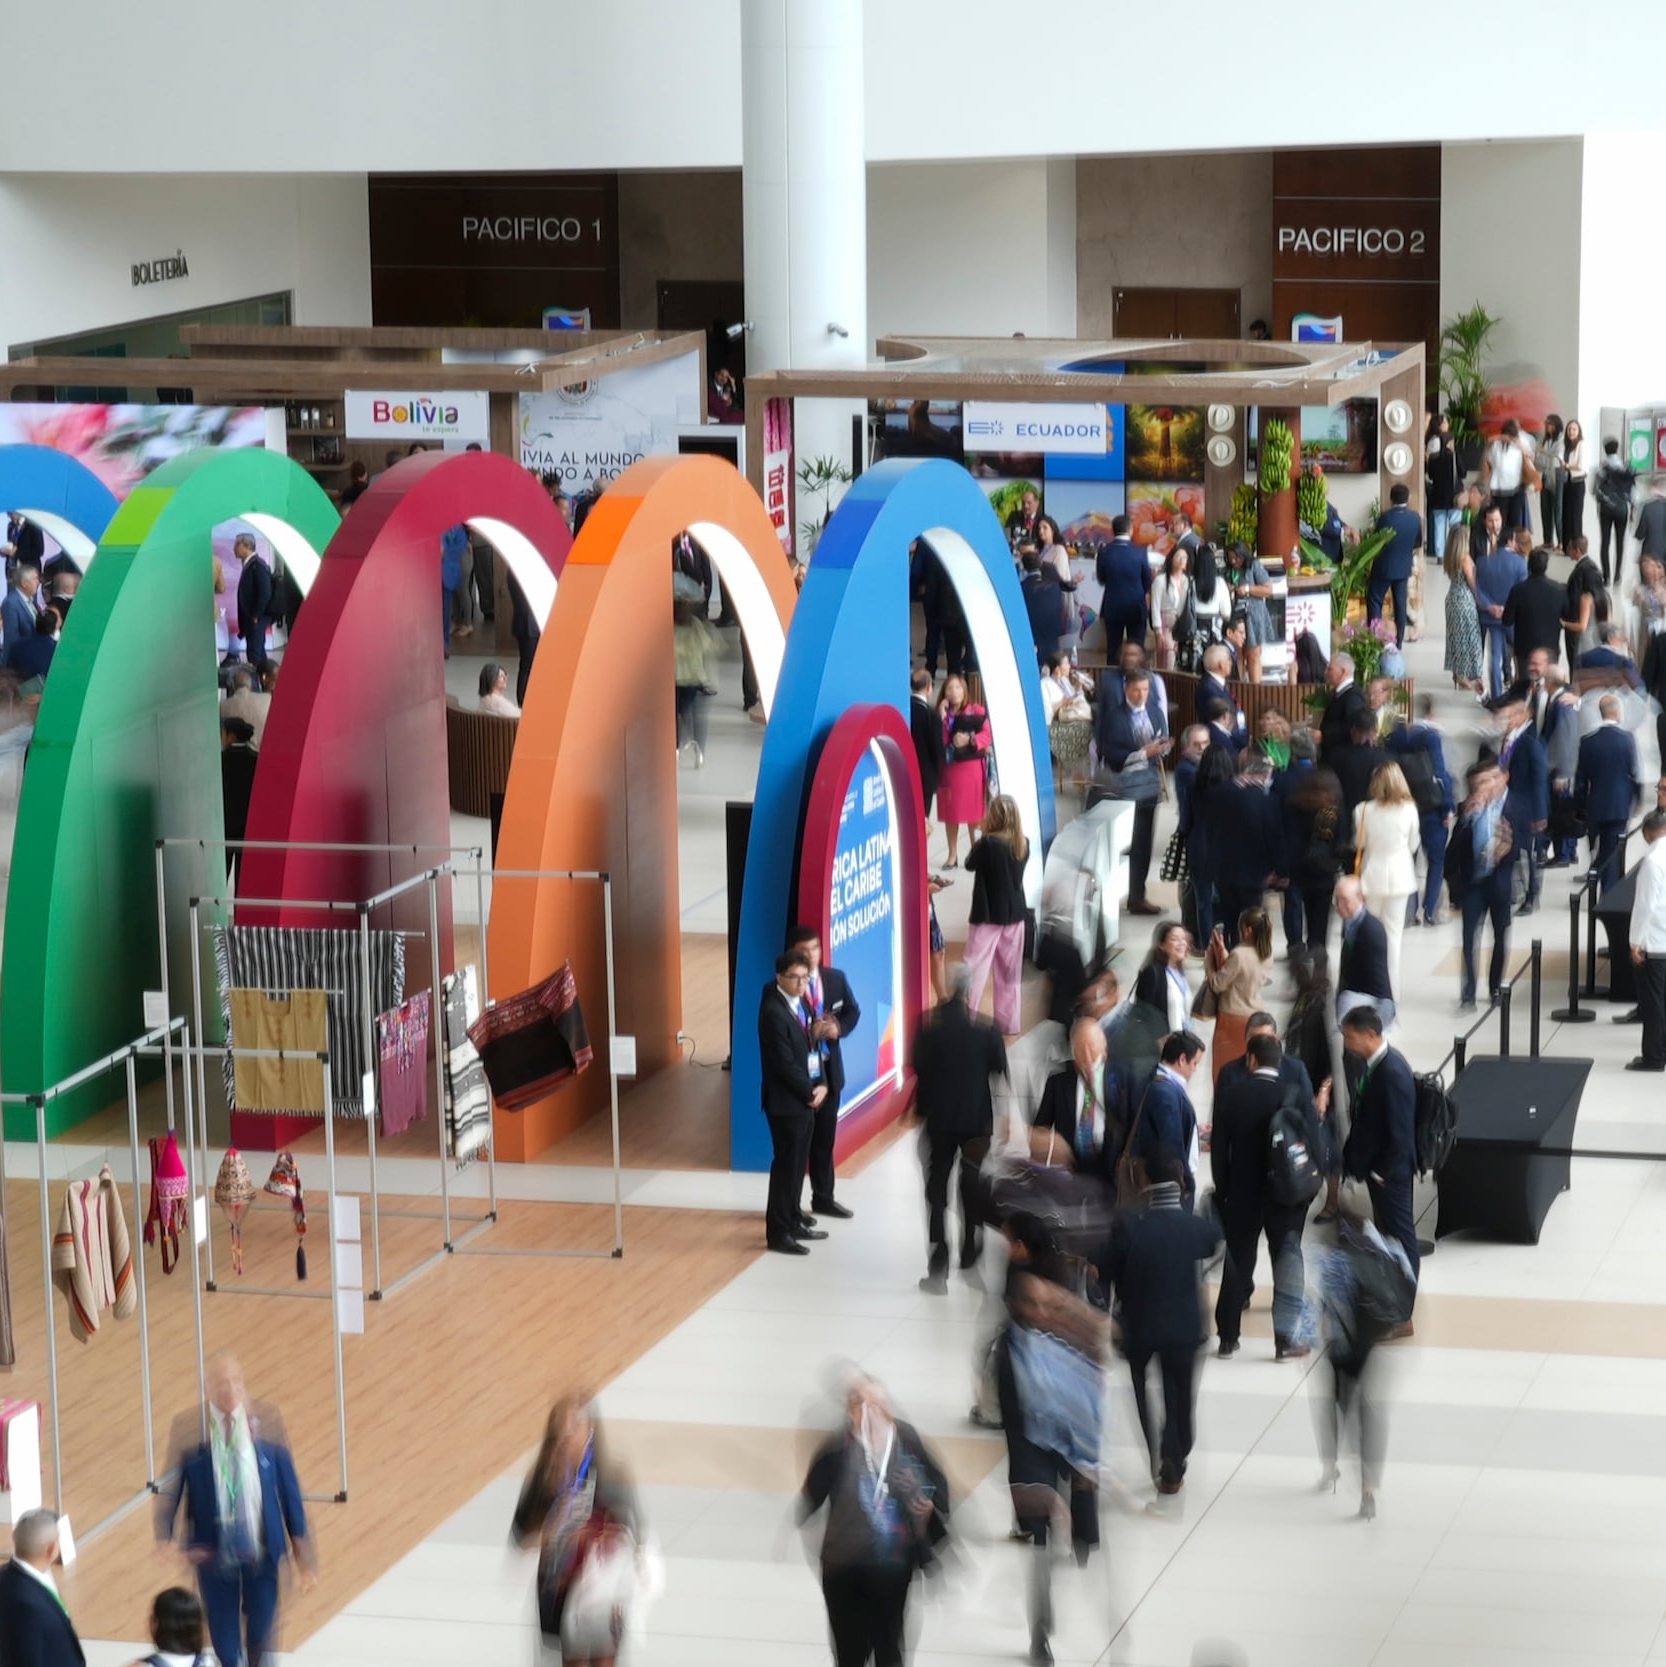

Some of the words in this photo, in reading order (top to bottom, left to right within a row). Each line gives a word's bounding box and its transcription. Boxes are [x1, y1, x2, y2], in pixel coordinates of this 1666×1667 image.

[462, 216, 581, 241] PACIFICO
[592, 218, 601, 241] 1
[1278, 227, 1405, 253] PACIFICO
[1409, 230, 1426, 253] 2
[131, 248, 189, 287] BOLETERÍA
[373, 398, 459, 425] Bolivia
[1016, 423, 1101, 437] ECUADOR
[522, 450, 554, 465] IVIA
[560, 451, 580, 465] AL
[583, 468, 594, 481] A
[832, 848, 858, 884] RICA
[830, 887, 844, 916] EL
[844, 861, 882, 905] CARIBE
[848, 890, 891, 935] SOLUCIÓN
